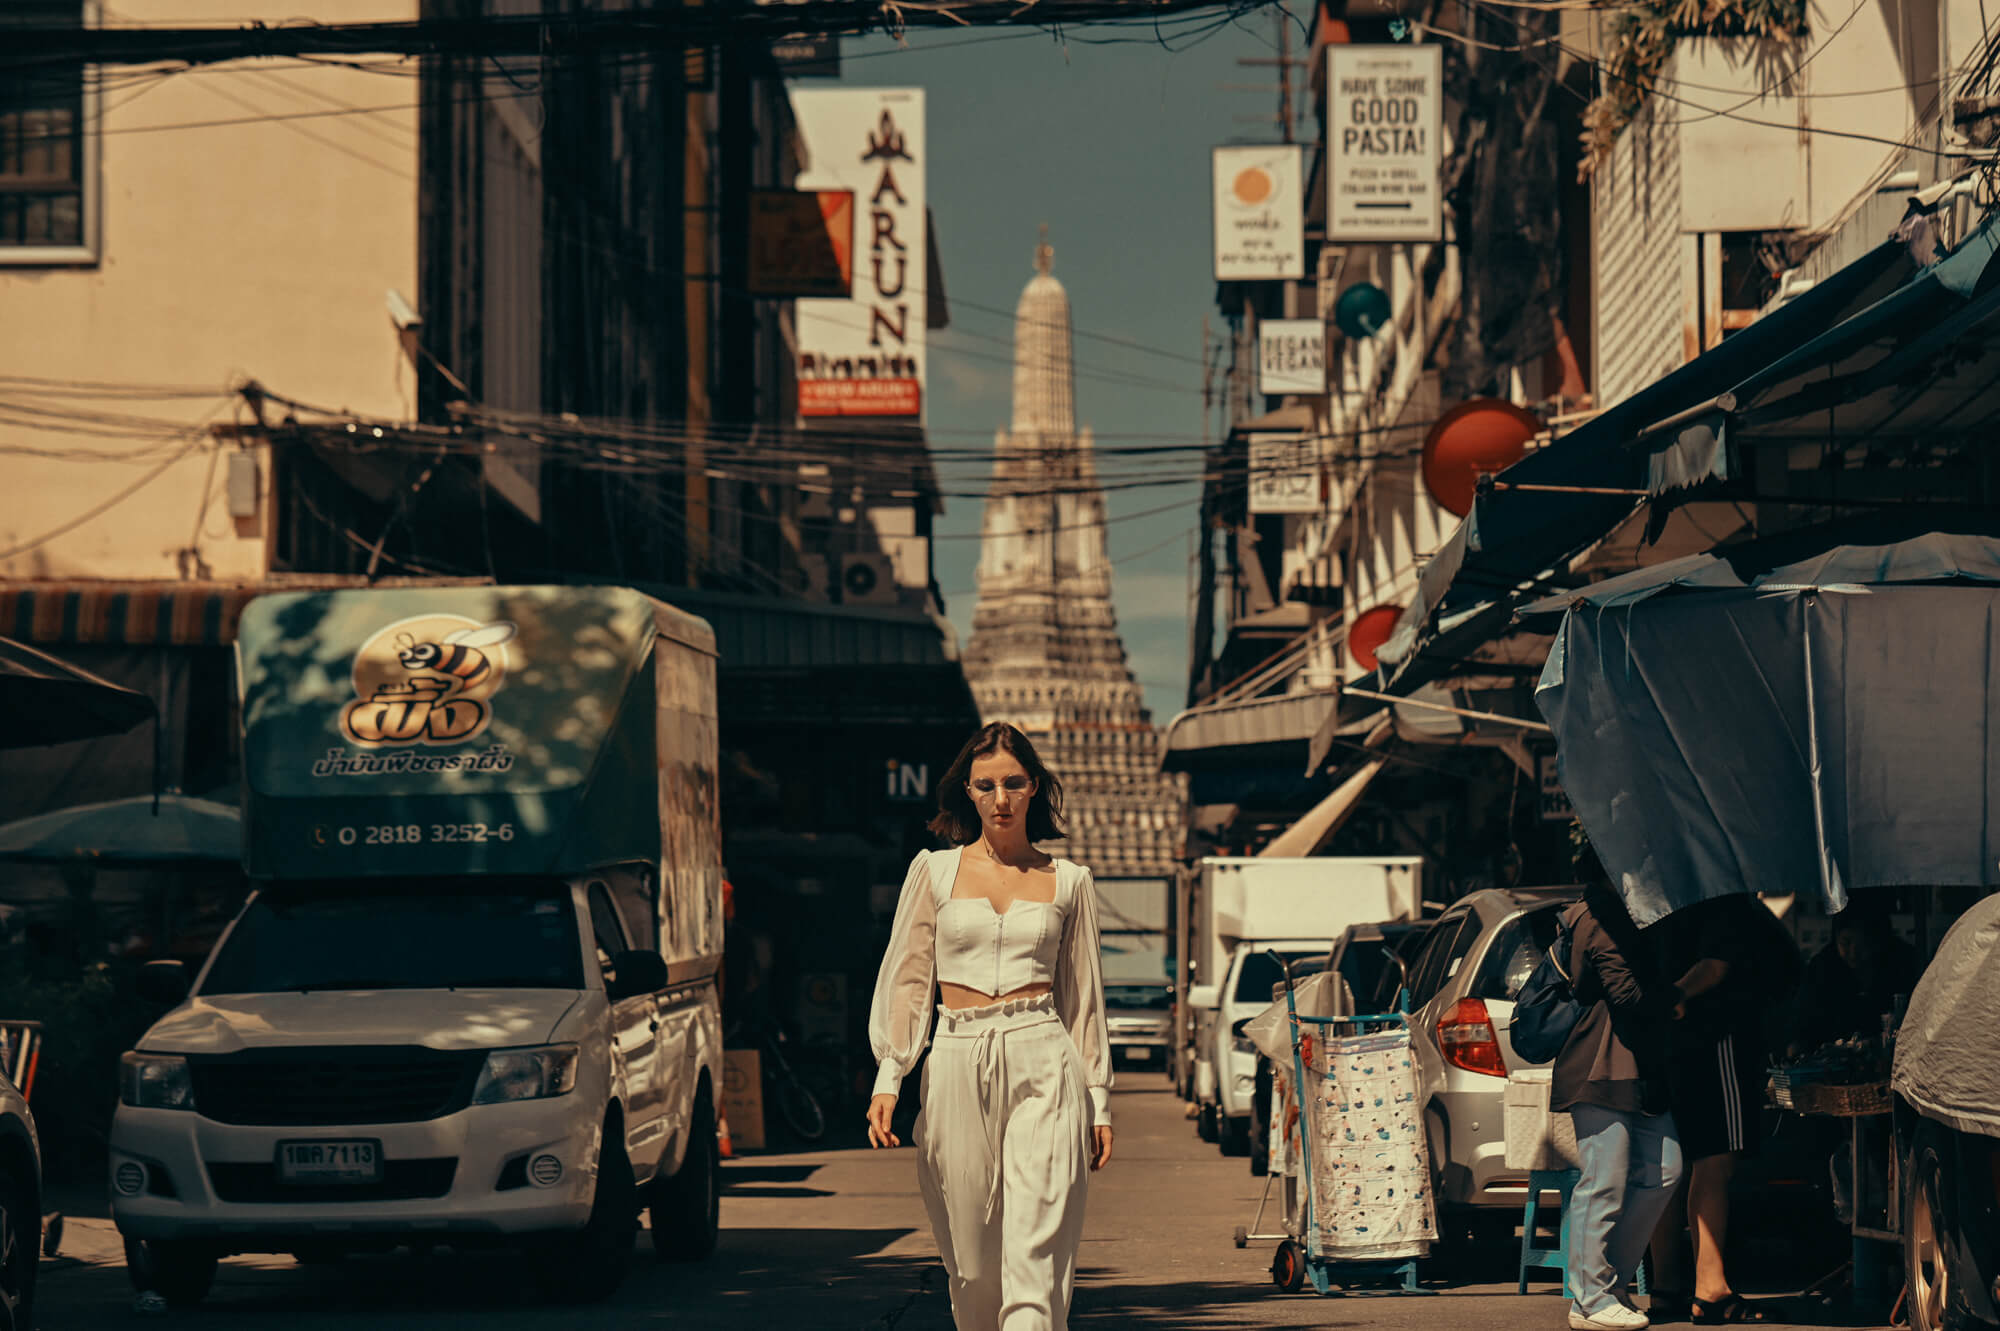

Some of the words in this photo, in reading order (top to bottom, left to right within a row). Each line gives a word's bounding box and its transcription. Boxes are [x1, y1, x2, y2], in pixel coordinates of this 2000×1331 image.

[1340, 77, 1378, 96] HAVE
[1385, 77, 1427, 96] SOME
[1351, 98, 1418, 125] GOOD
[1343, 128, 1425, 155] PASTA!
[870, 167, 907, 346] ARUN
[366, 825, 421, 845] 2818
[431, 823, 514, 843] 3252-6
[327, 1145, 372, 1164] 7113
